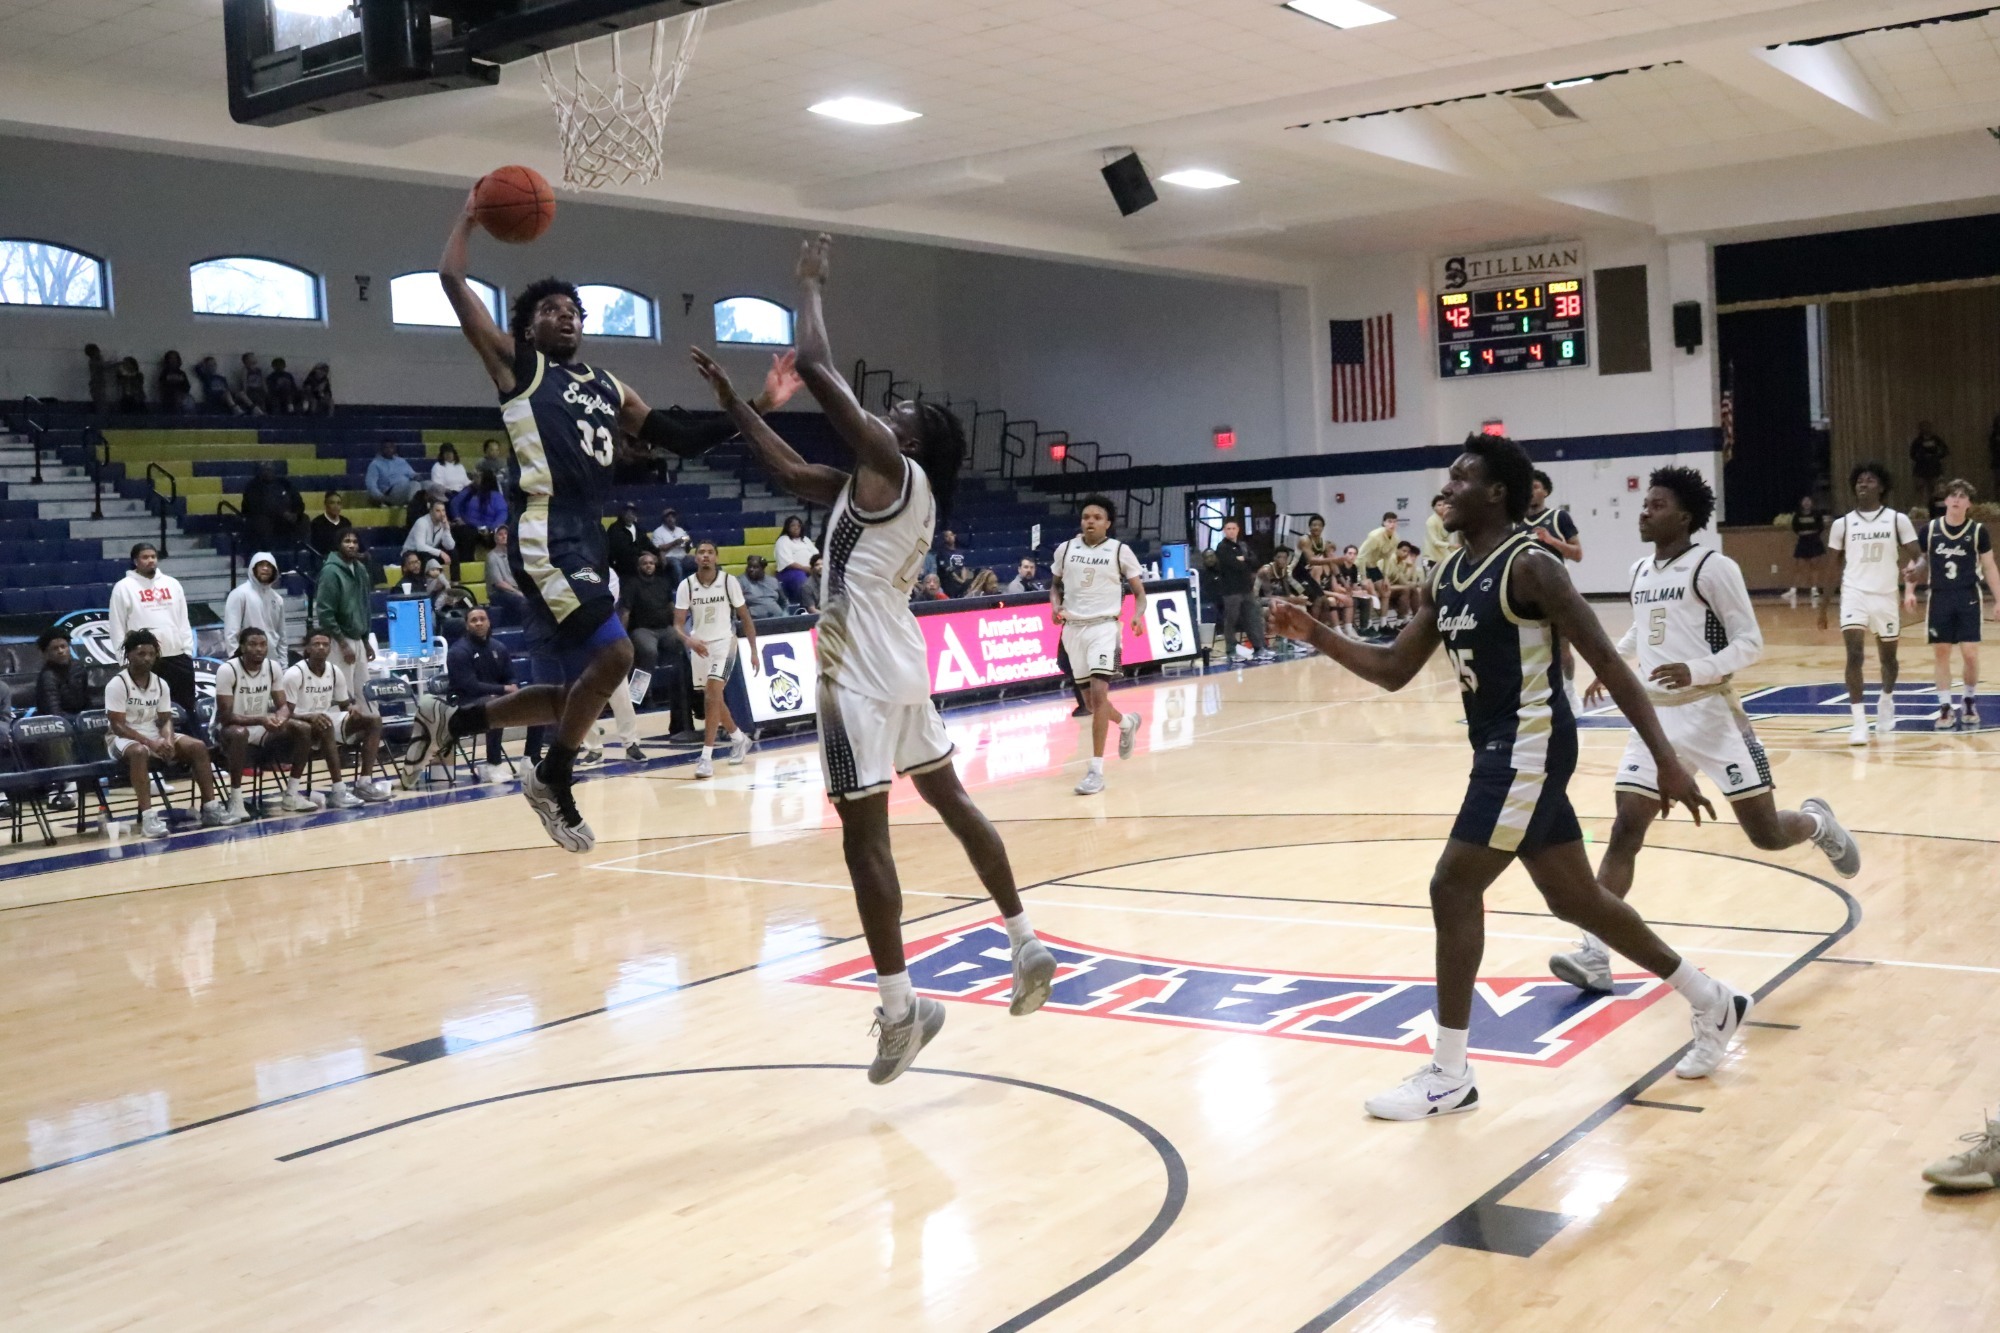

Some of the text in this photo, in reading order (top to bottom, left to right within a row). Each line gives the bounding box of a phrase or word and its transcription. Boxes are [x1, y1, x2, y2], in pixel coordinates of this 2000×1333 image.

[1445, 249, 1578, 289] STILLMAN
[1496, 287, 1541, 311] 1:51
[1555, 295, 1581, 317] 38
[1445, 307, 1470, 328] 42
[1522, 317, 1529, 333] 1
[1482, 349, 1494, 364] 4
[1530, 344, 1541, 360] 4
[1562, 341, 1574, 358] 8
[1459, 351, 1471, 368] 5
[1851, 531, 1891, 541] STILLMAN
[1860, 542, 1884, 562] 10
[1935, 543, 1967, 559] Eagles
[1070, 555, 1110, 566] STILLMAN
[1080, 568, 1096, 587] 3
[1944, 561, 1958, 579] 3
[692, 595, 725, 605] STILLMAN
[1634, 586, 1685, 605] STILLMAN
[418, 602, 427, 641] POWERADE
[704, 607, 715, 624] 2
[1437, 603, 1478, 641] Eagles
[978, 615, 1043, 638] American
[1648, 608, 1666, 645] 5
[981, 637, 1042, 661] Diabetes
[371, 684, 406, 695] TIGERS
[20, 720, 66, 738] TIGERS
[83, 715, 110, 729] TIGE
